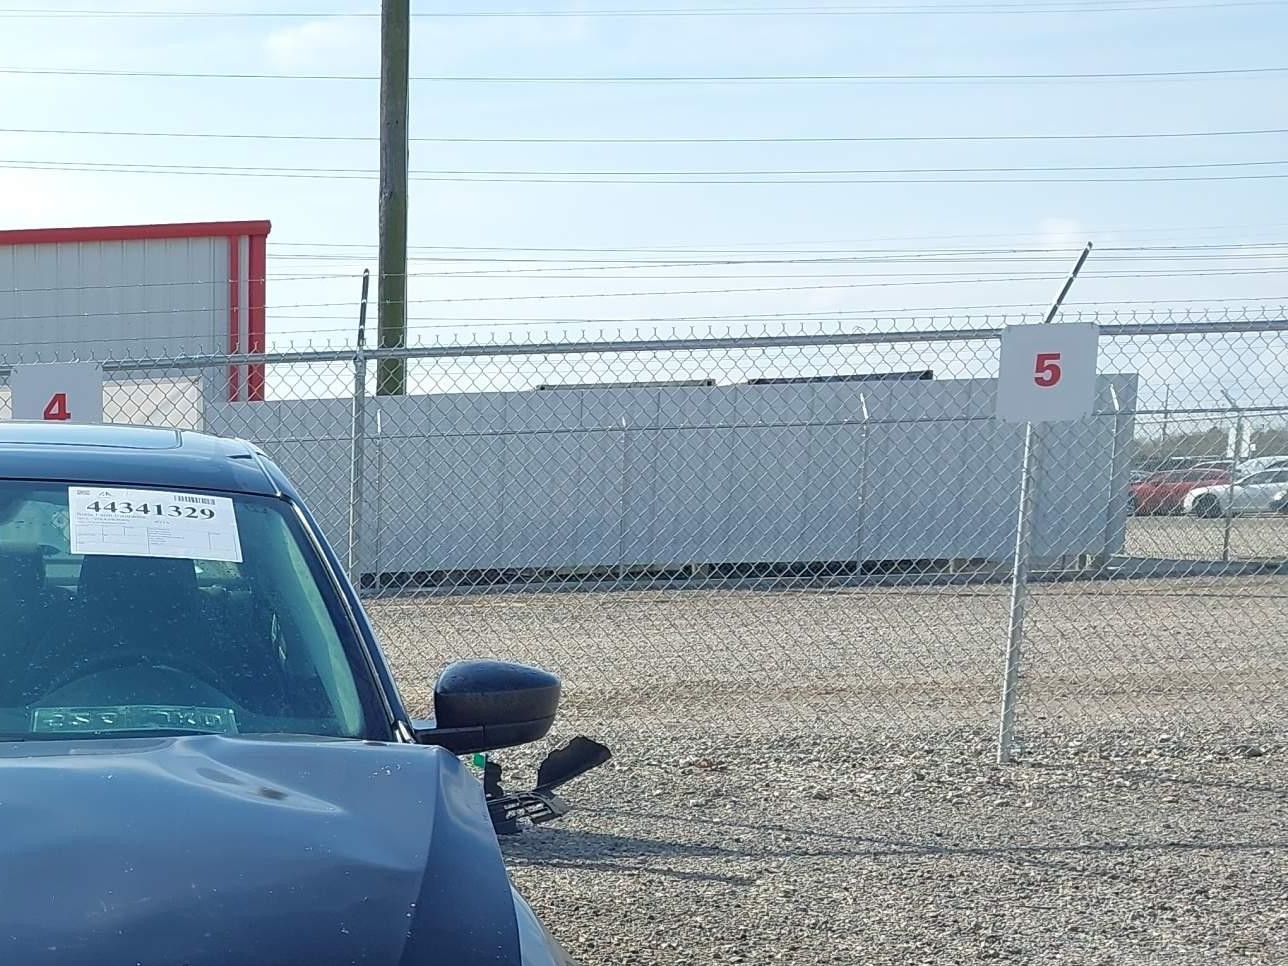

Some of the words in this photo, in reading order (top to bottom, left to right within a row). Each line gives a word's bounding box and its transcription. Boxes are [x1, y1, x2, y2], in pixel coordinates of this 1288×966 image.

[1035, 353, 1060, 387] 5
[44, 393, 70, 420] 4
[87, 501, 215, 520] 44341329
